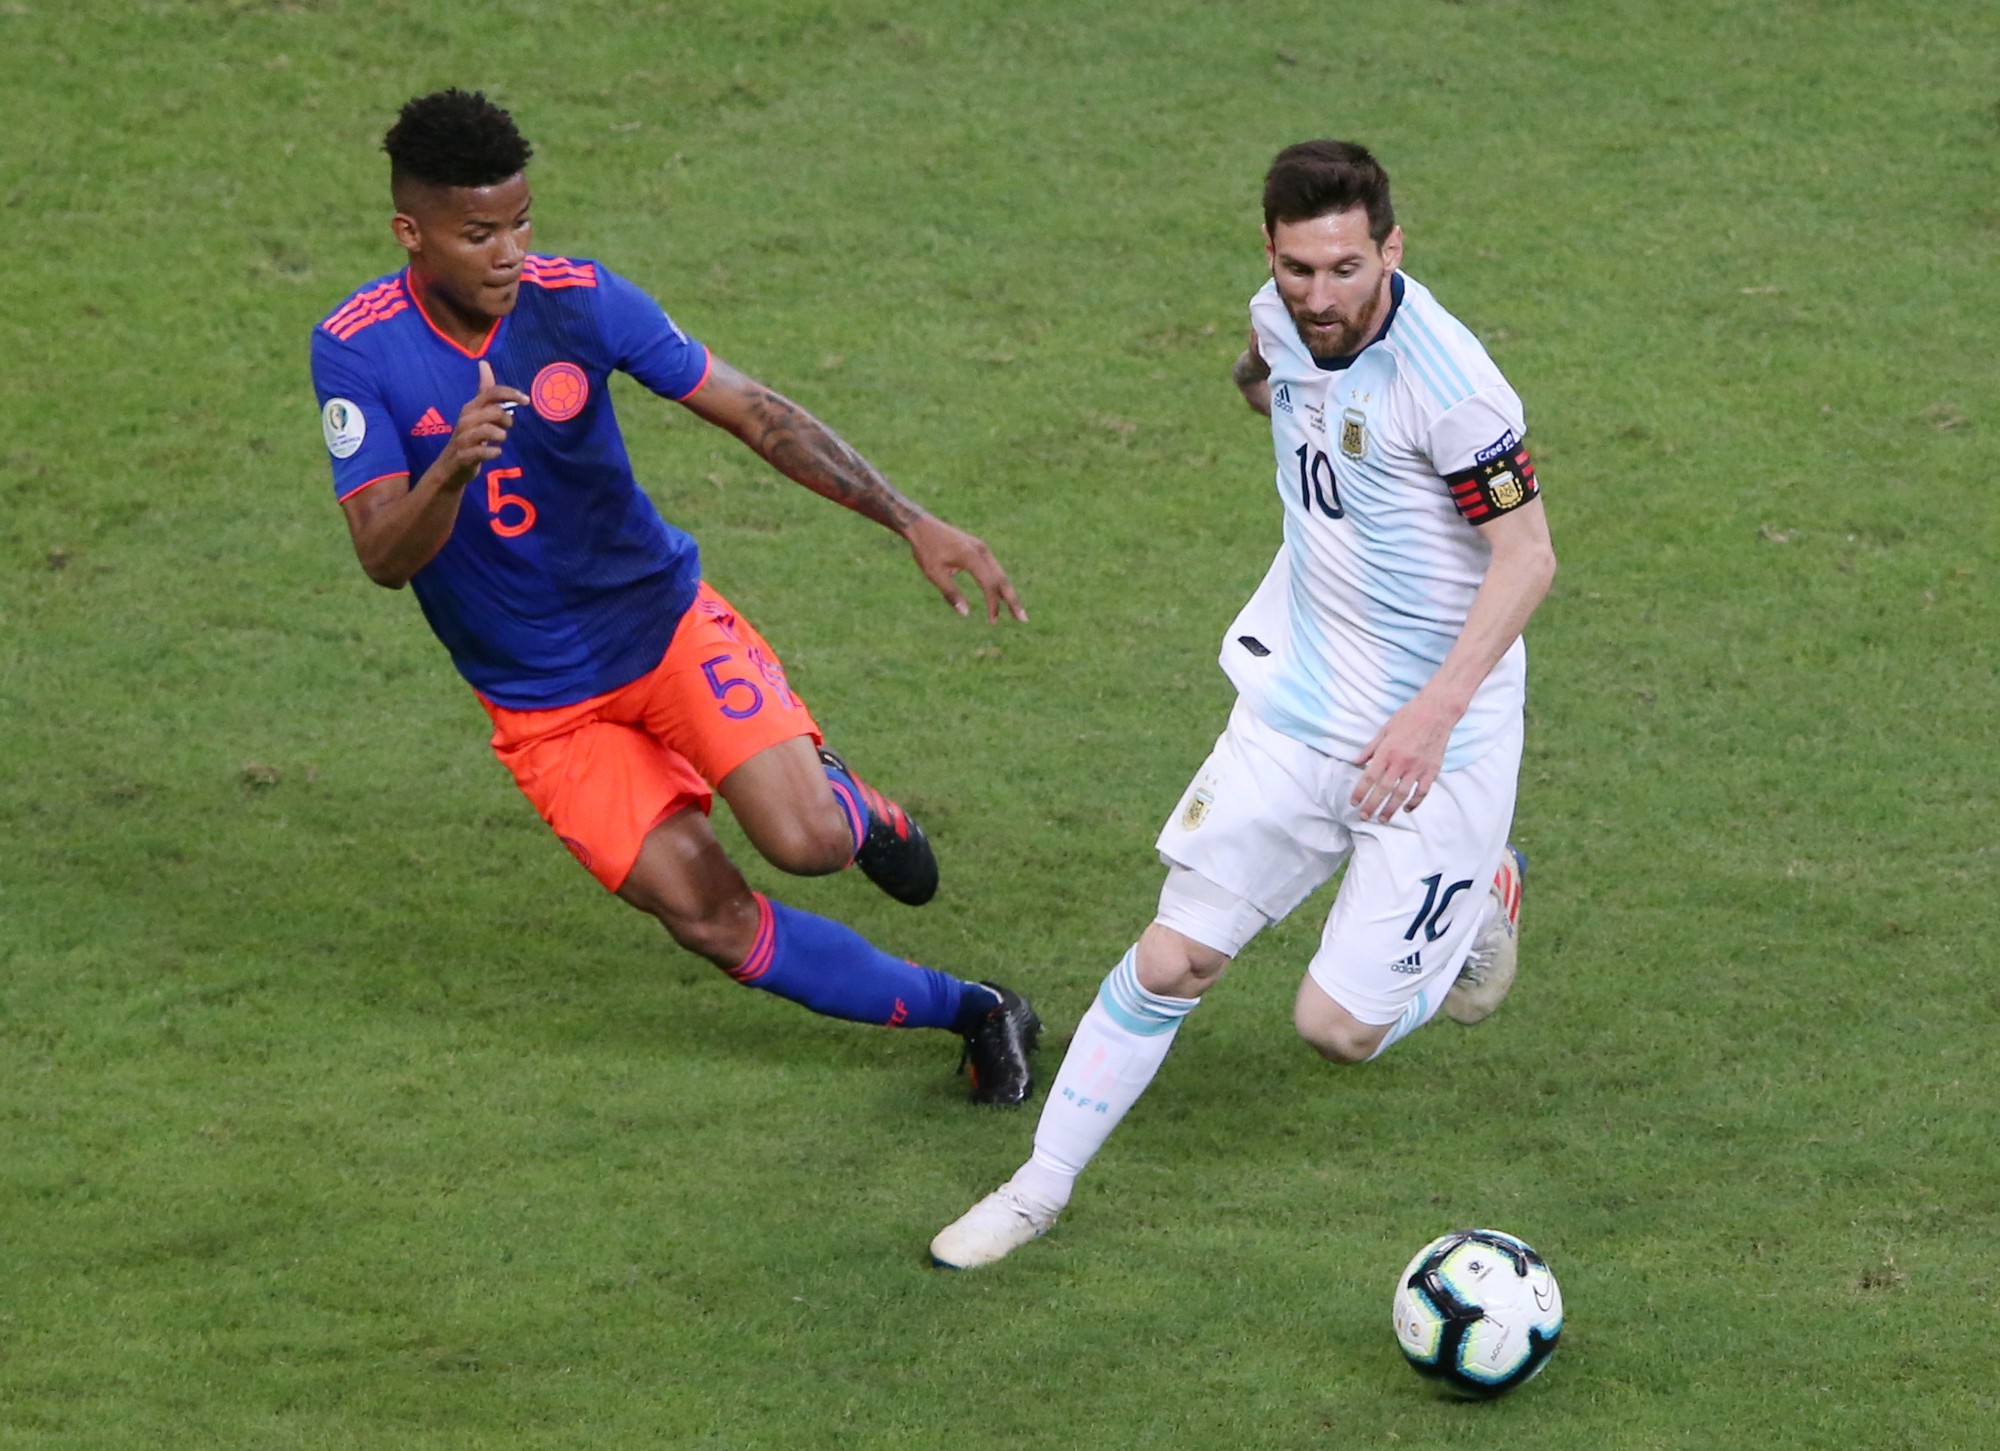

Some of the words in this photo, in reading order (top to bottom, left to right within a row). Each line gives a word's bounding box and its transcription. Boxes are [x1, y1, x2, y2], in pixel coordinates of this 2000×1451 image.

[486, 466, 537, 537] 5
[1295, 442, 1344, 519] 10
[700, 653, 763, 720] 5
[1403, 873, 1474, 942] 10
